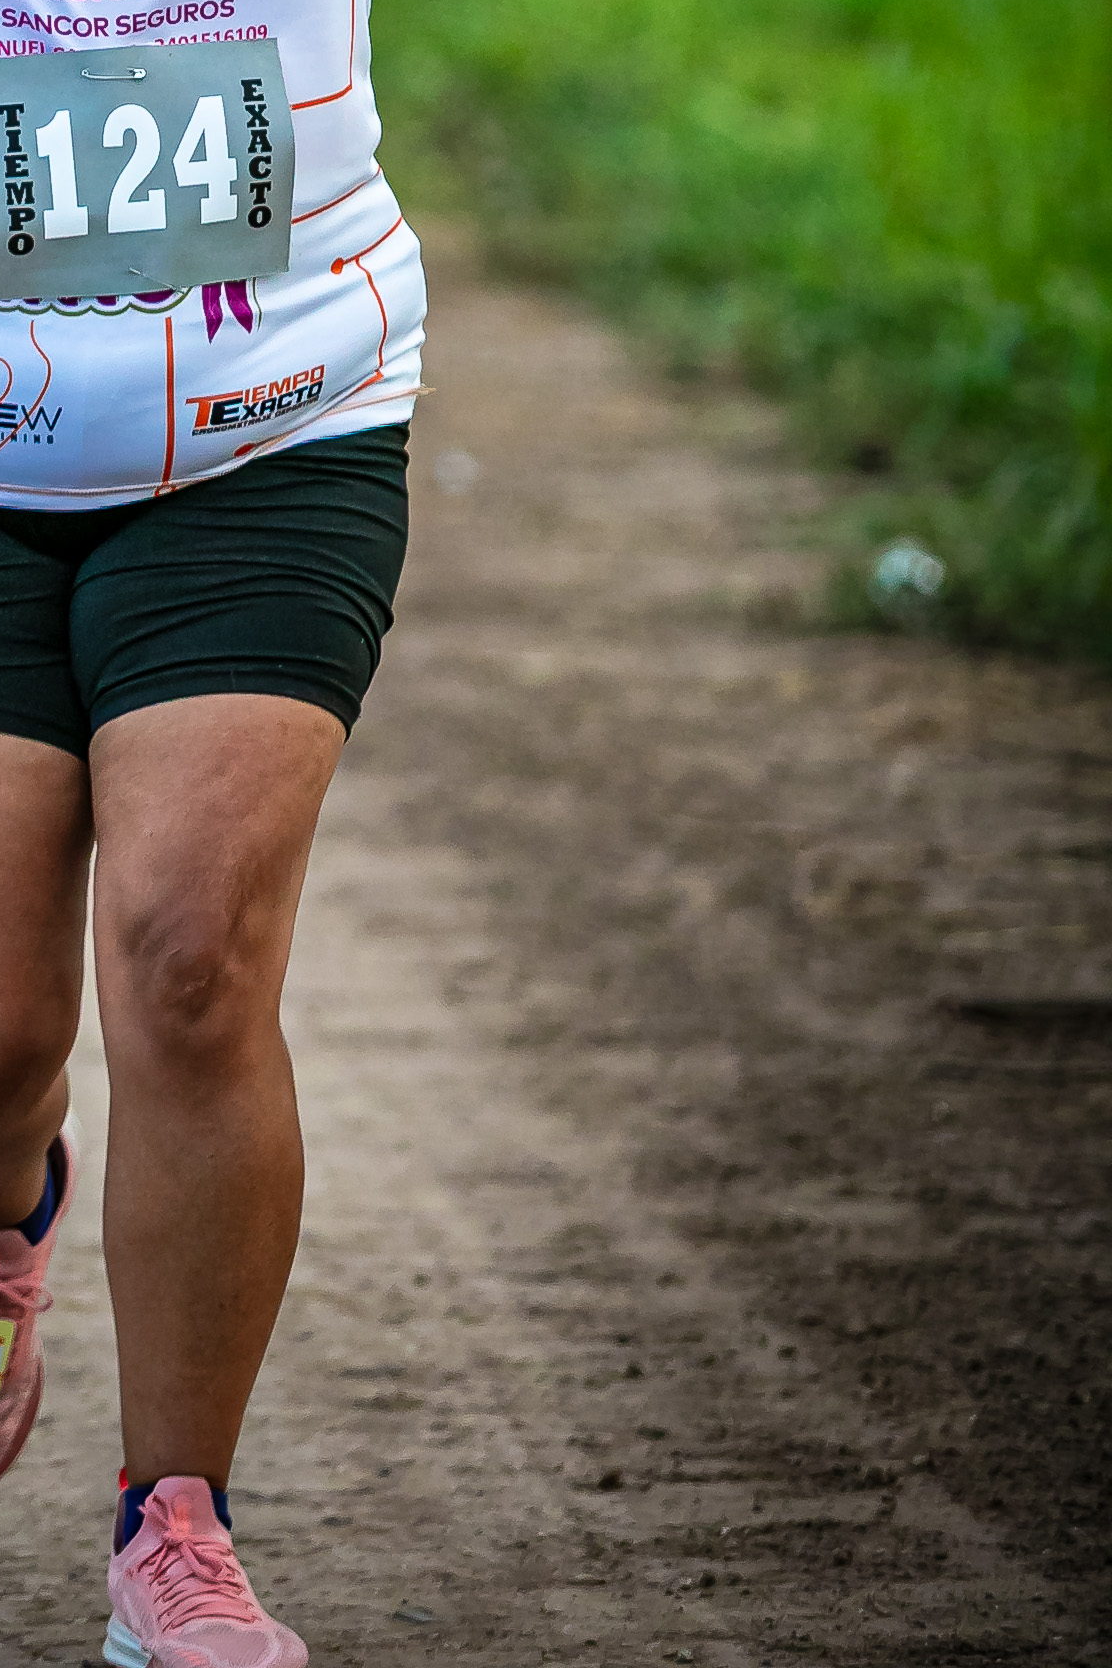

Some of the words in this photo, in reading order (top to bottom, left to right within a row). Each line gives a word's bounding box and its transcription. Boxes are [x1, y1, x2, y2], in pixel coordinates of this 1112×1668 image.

[1, 8, 109, 39] SANCOR
[35, 94, 238, 241] 124
[240, 78, 274, 229] EXACTO
[185, 364, 325, 428] TIEMPO
[210, 380, 324, 426] EXACTO
